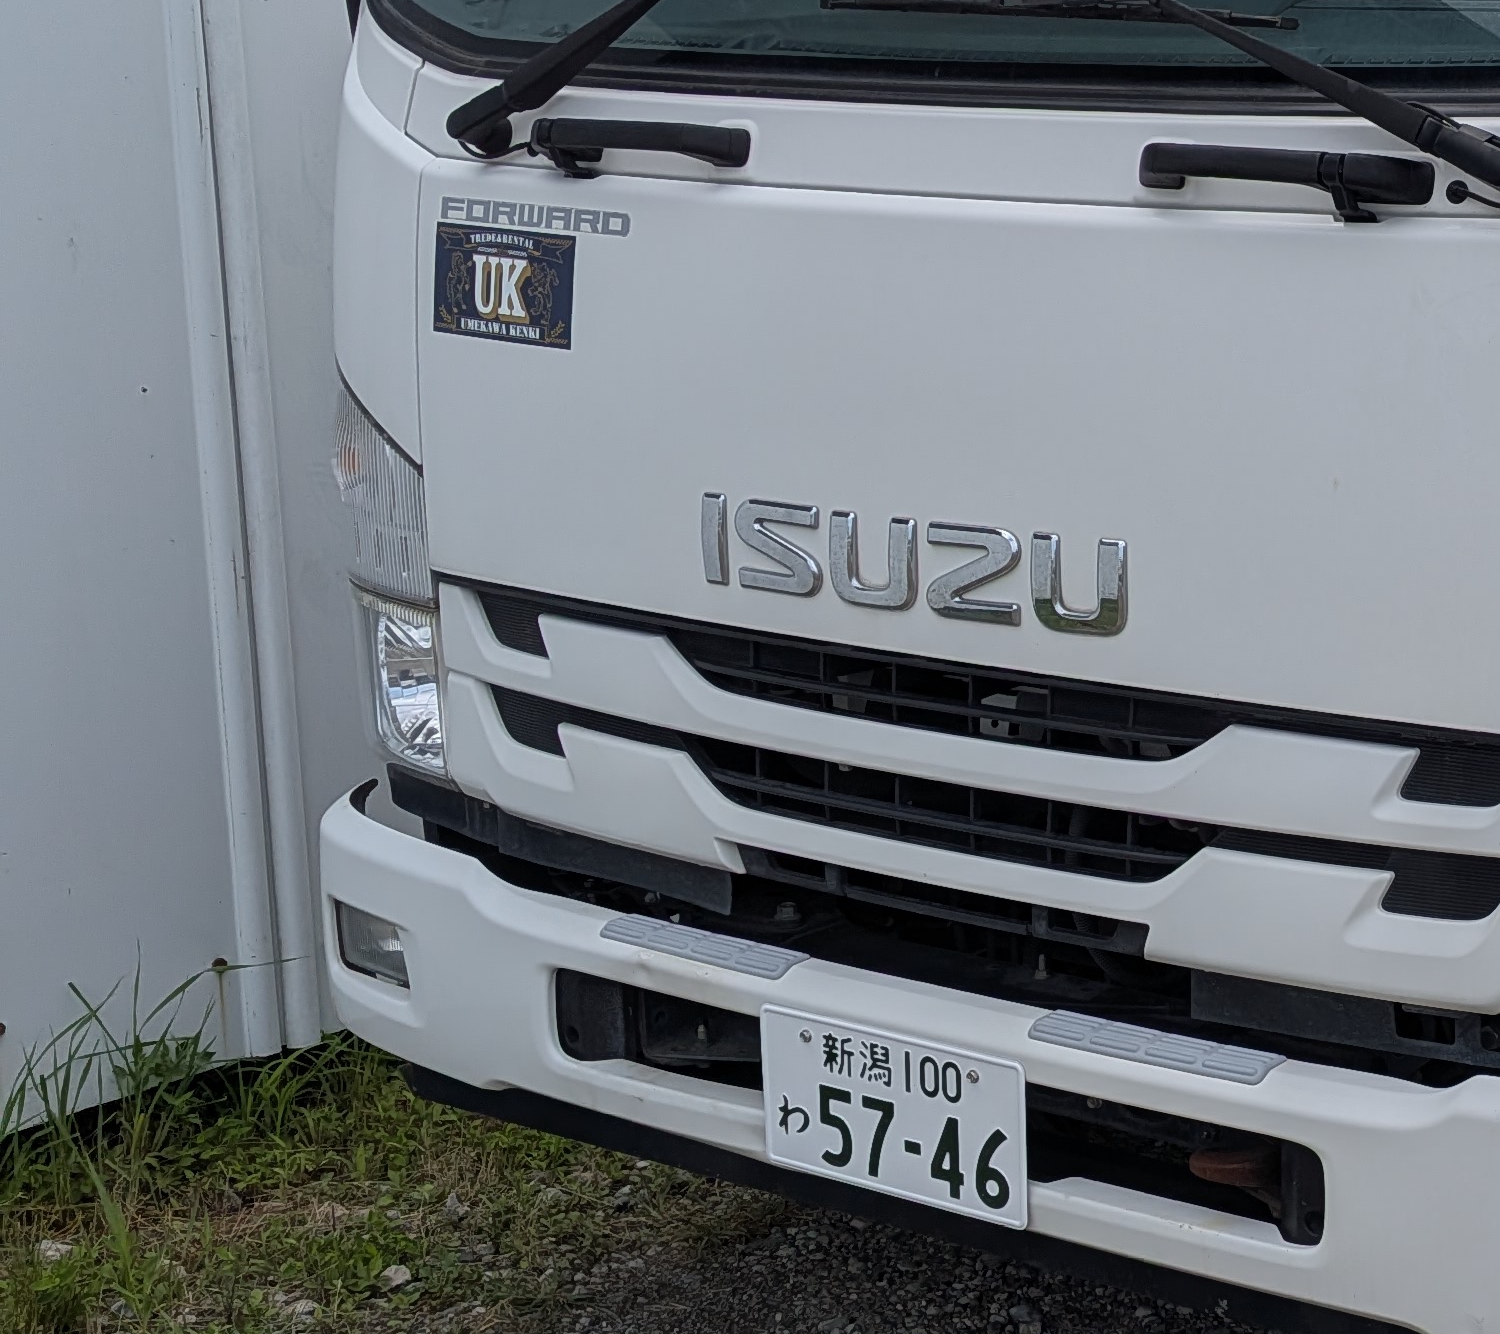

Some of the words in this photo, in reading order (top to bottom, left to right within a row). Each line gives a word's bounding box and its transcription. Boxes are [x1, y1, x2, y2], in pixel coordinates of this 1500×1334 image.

[441, 196, 631, 237] FORWARD
[473, 253, 530, 318] UK
[460, 317, 507, 336] UMEKAWA
[509, 324, 540, 339] KENKI
[701, 492, 1128, 637] ISUZU
[822, 1033, 892, 1087] 新潟
[904, 1050, 962, 1103] 100
[778, 1094, 810, 1135] わ
[818, 1083, 1011, 1209] 57-46
